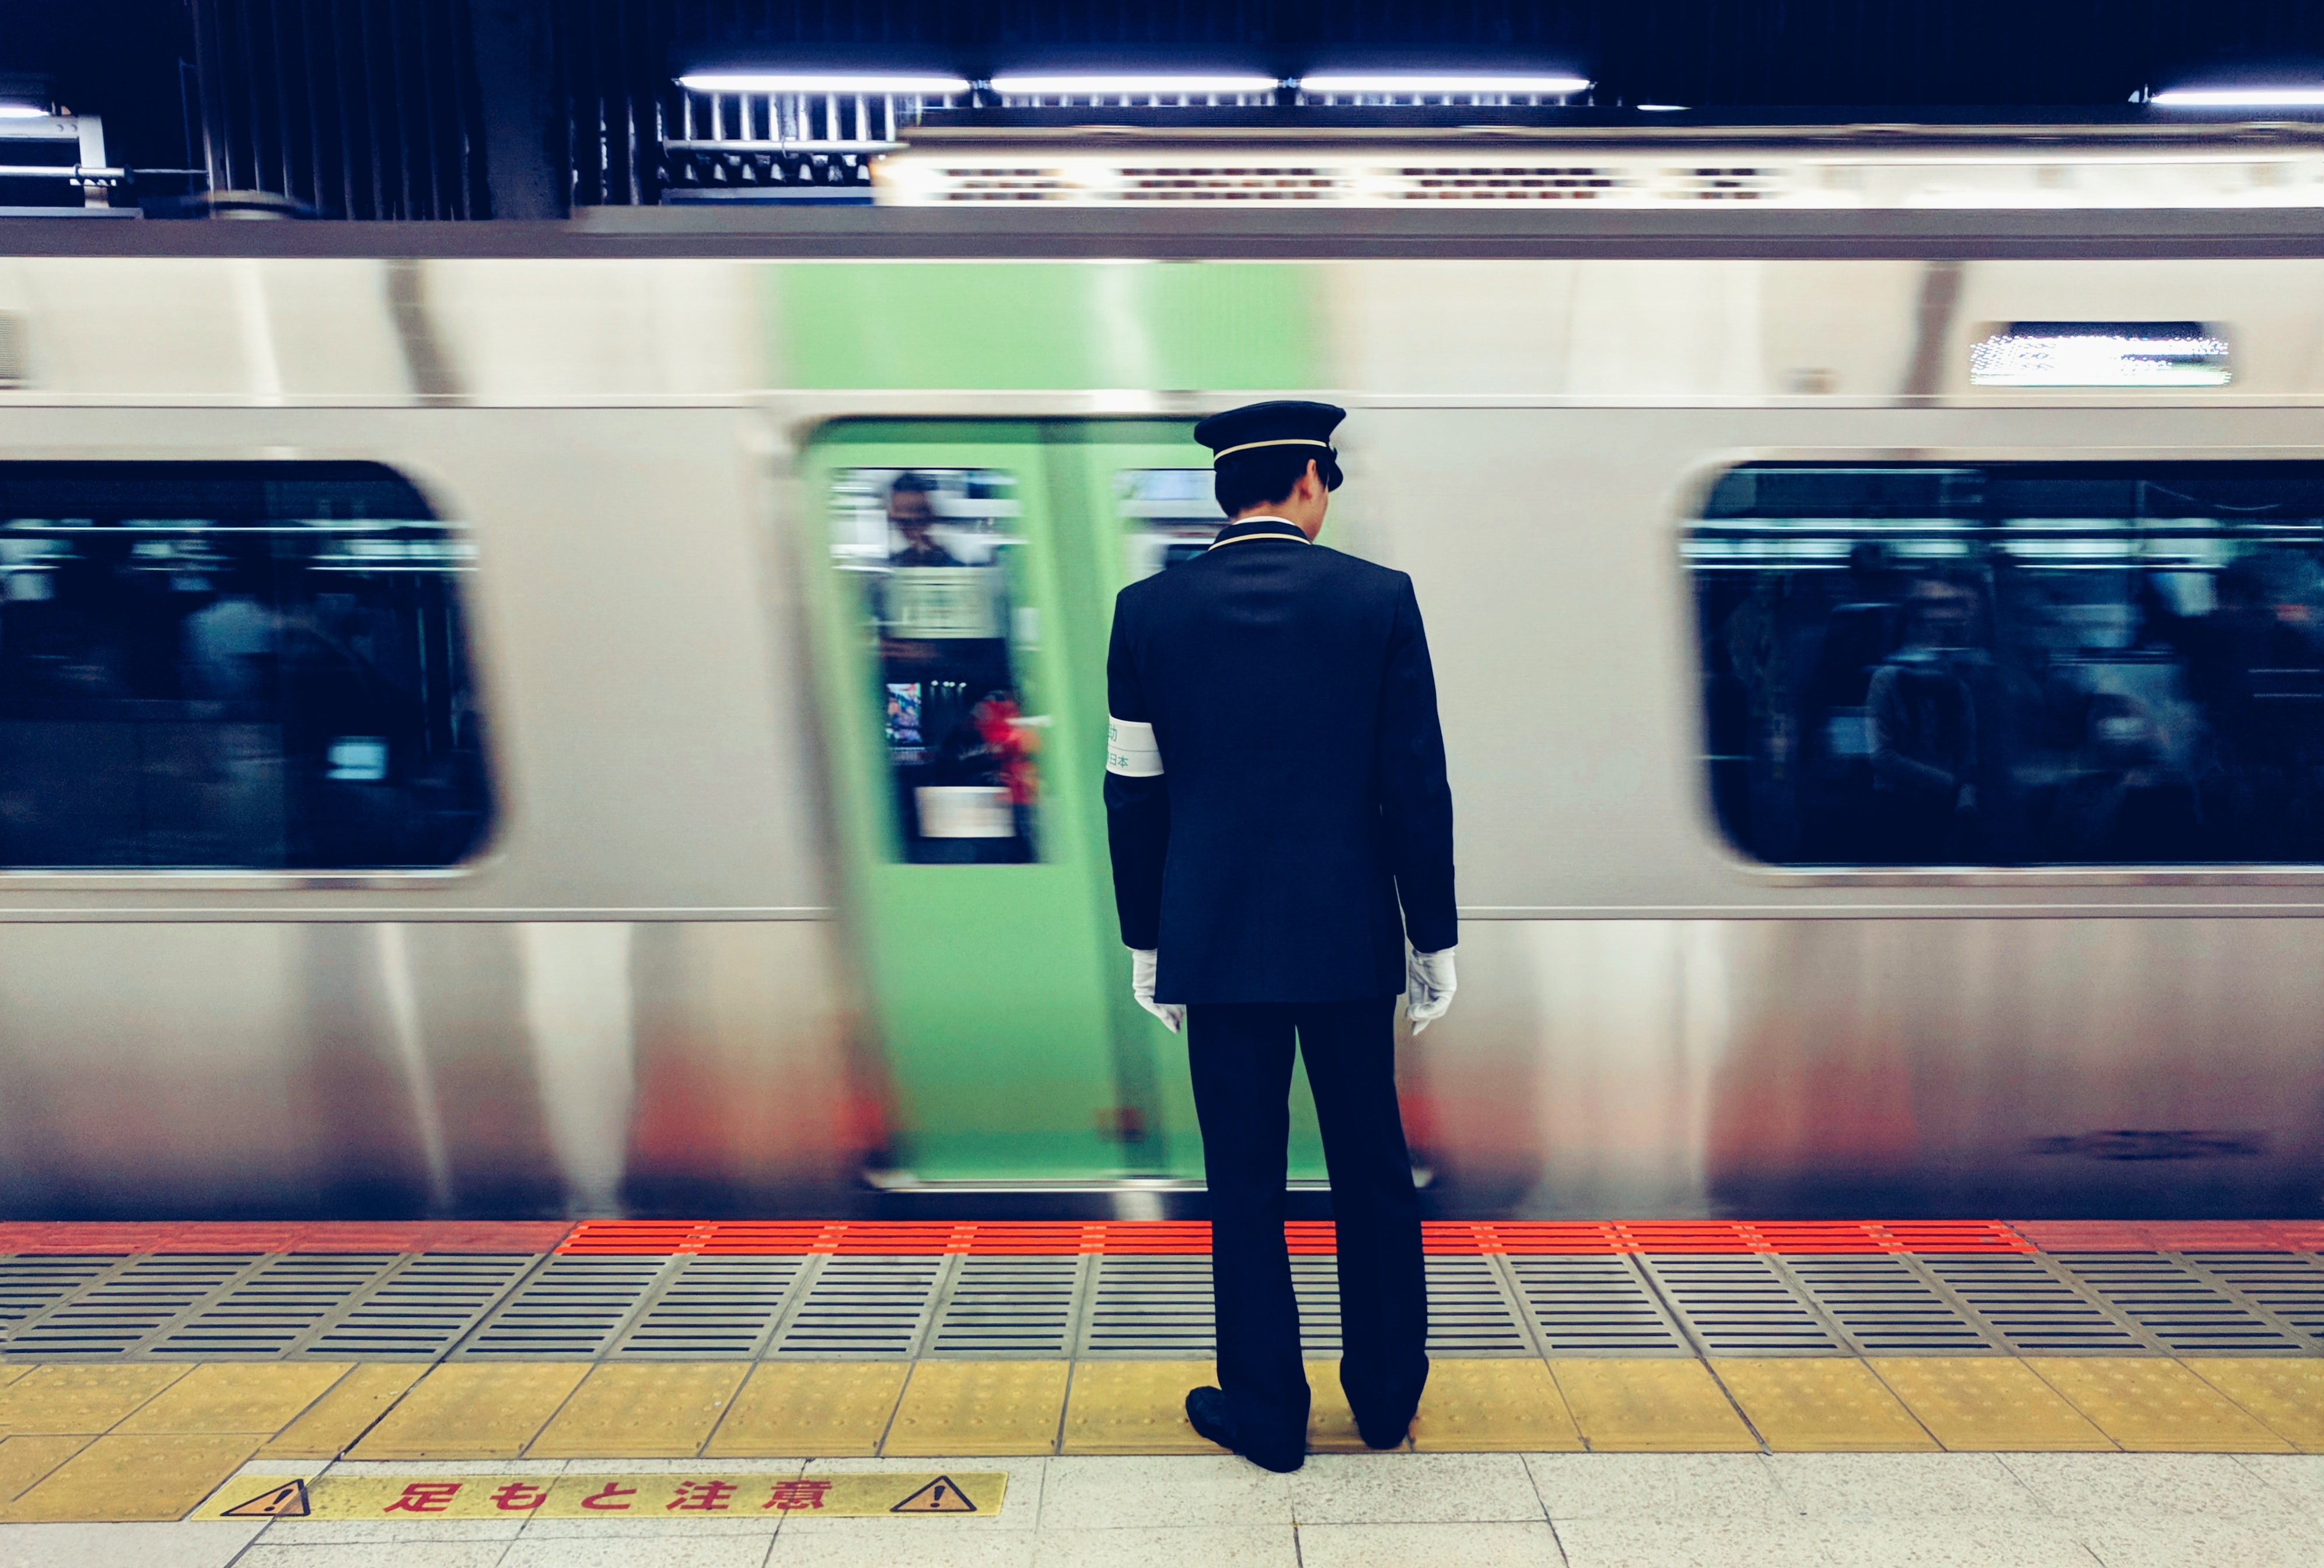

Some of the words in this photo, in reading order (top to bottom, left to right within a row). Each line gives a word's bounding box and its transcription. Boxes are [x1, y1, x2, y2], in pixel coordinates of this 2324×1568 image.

[383, 1479, 833, 1513] 足もと注意
